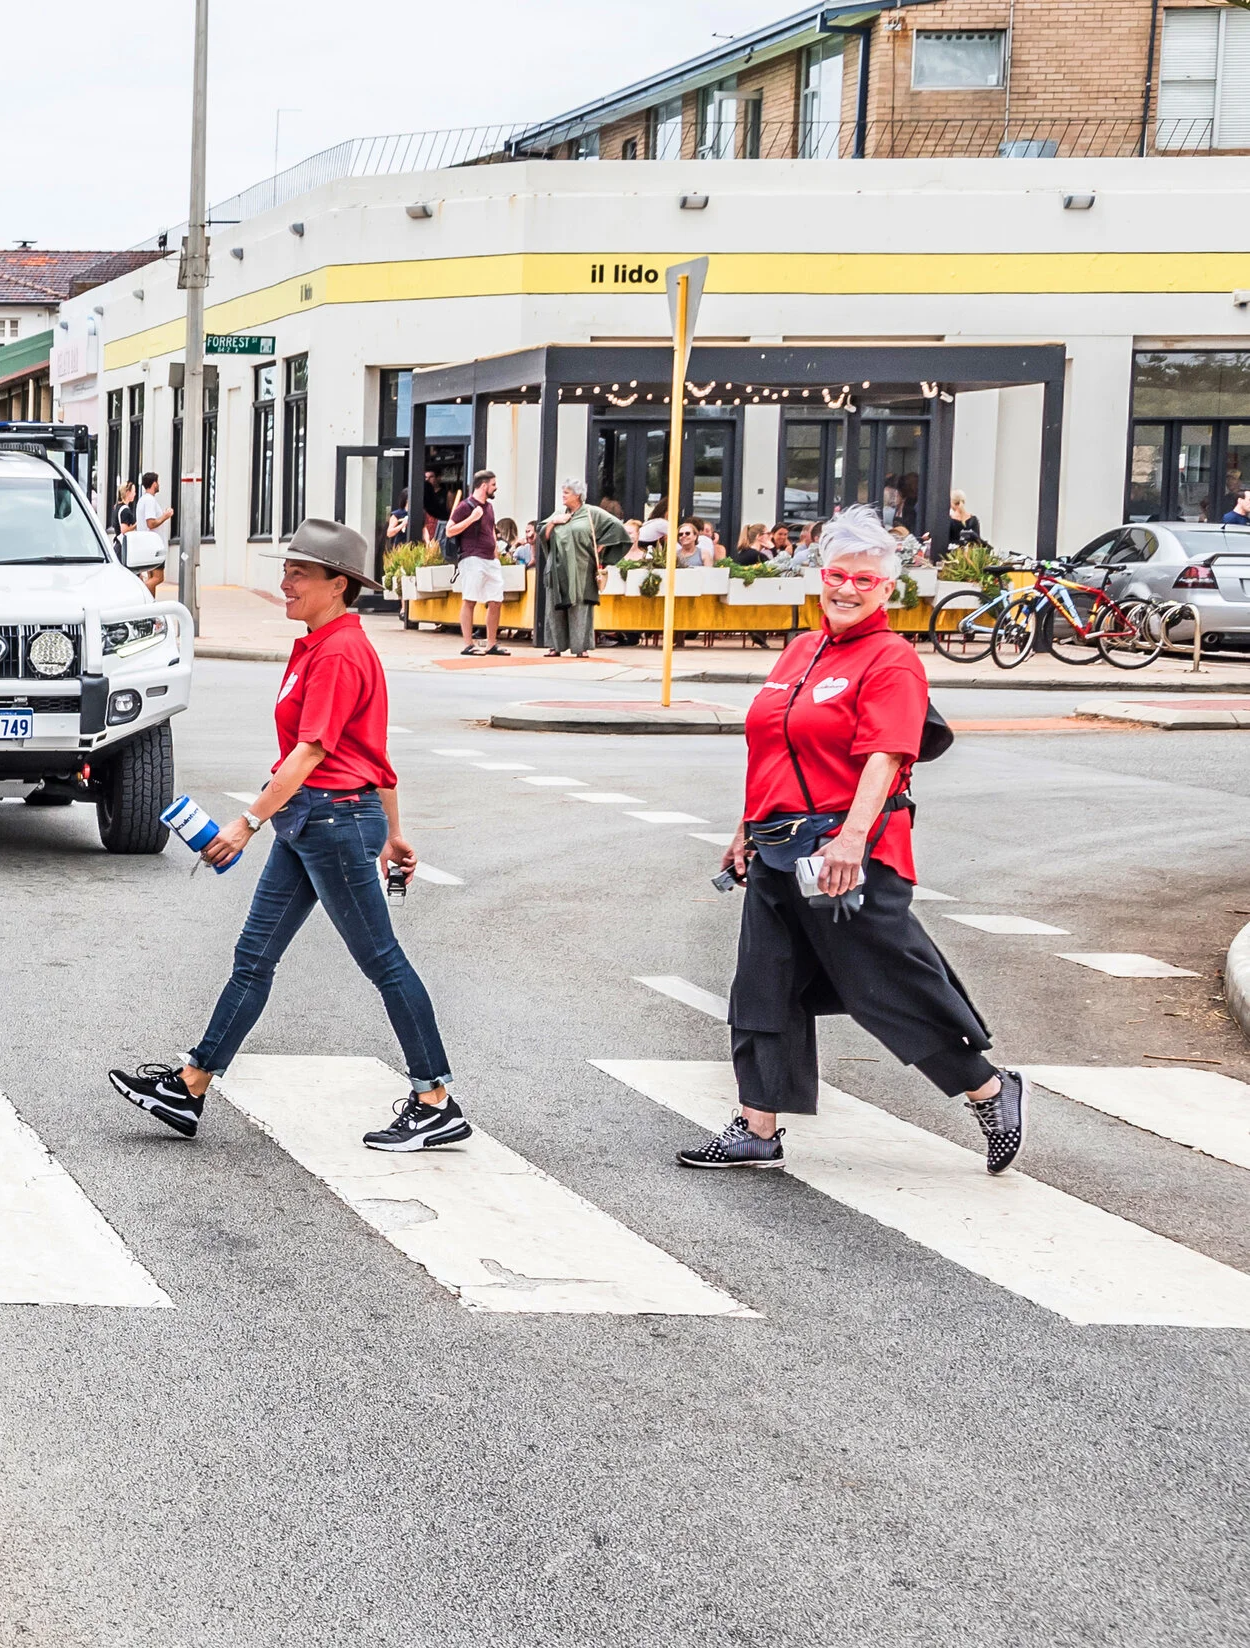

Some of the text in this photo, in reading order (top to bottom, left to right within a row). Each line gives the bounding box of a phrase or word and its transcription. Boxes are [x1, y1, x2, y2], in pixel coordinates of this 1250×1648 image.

[591, 264, 659, 283] il lido
[207, 336, 251, 348] FORREST
